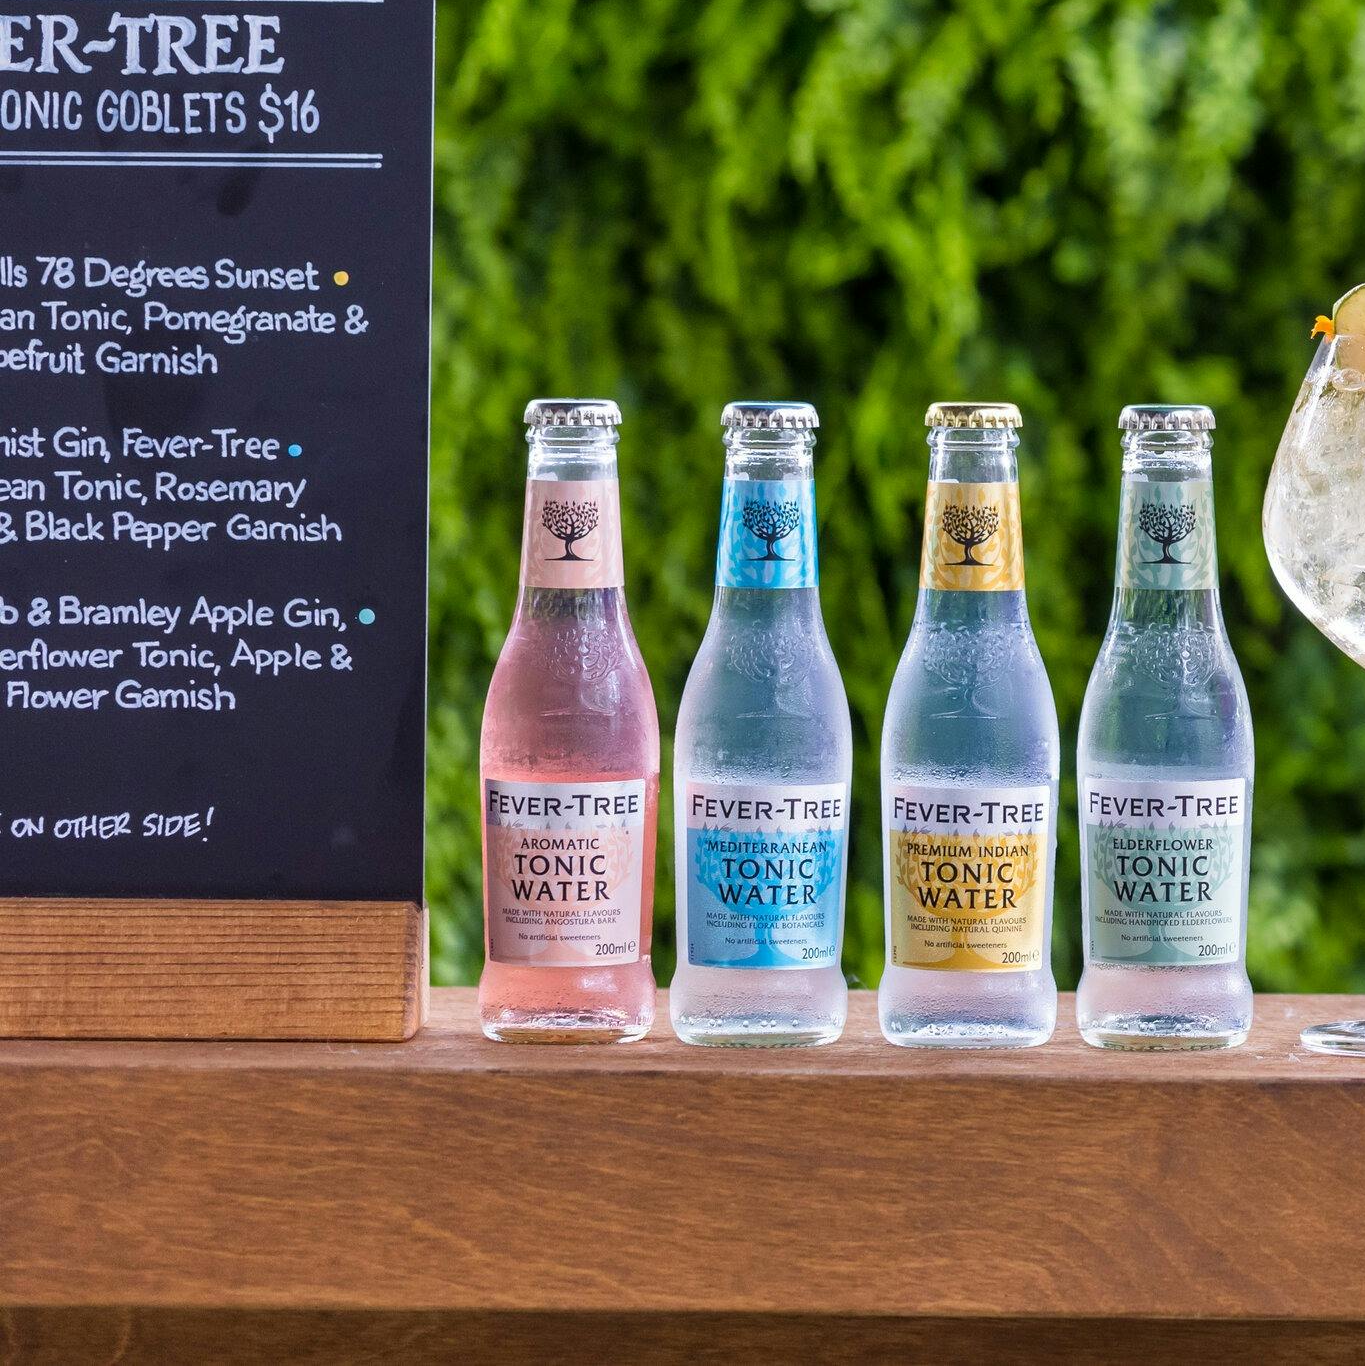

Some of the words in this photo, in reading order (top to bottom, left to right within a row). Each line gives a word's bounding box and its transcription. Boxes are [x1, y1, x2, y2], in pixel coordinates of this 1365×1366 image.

[97, 90, 246, 134] GOBLETS
[259, 83, 319, 143] $16
[36, 256, 75, 288] 78
[84, 257, 209, 297] Degrees
[215, 259, 319, 290] Sunset
[41, 301, 131, 334] Tonic,
[145, 301, 336, 344] Pomegranate
[345, 305, 369, 334] &
[96, 342, 217, 375] Garnish
[53, 427, 110, 463] Gin,
[123, 428, 280, 460] Fever-Tree
[54, 471, 147, 505] Tonic,
[156, 472, 306, 508] Rosemary
[26, 510, 104, 541] Black
[113, 511, 216, 551] Pepper
[227, 513, 342, 541] Garnish
[28, 598, 51, 626] &
[59, 596, 180, 633] Bramley
[190, 596, 274, 634] Apple
[284, 599, 346, 631] Gin,
[132, 641, 220, 676] Tonic,
[231, 639, 322, 675] Apple
[331, 644, 352, 670] &
[7, 681, 109, 709] Flower
[116, 680, 235, 710] Garnish
[489, 790, 638, 816] FEVER-TREE
[693, 794, 841, 820] FEVER-TREE
[894, 797, 1043, 824] FEVER-TREE
[1090, 792, 1238, 817] FEVER-TREE
[11, 817, 44, 837] ON
[54, 812, 131, 839] OTHER
[143, 807, 214, 842] SIDE!
[520, 838, 599, 850] AROMATIC
[708, 841, 826, 853] MEDITERRANEAN
[907, 844, 972, 857] PREMIUM
[978, 845, 1029, 857] INDIAN
[1113, 838, 1213, 850] ELDERFLOWER
[515, 854, 606, 875] TONIC
[722, 858, 813, 879] TONIC
[921, 862, 1013, 883] TONIC
[1117, 855, 1208, 876] TONIC
[512, 881, 610, 901] WATER
[719, 884, 816, 905] WATER
[918, 888, 1016, 909] WATER
[1114, 881, 1212, 902] WATER
[506, 916, 542, 924] INCLUDING
